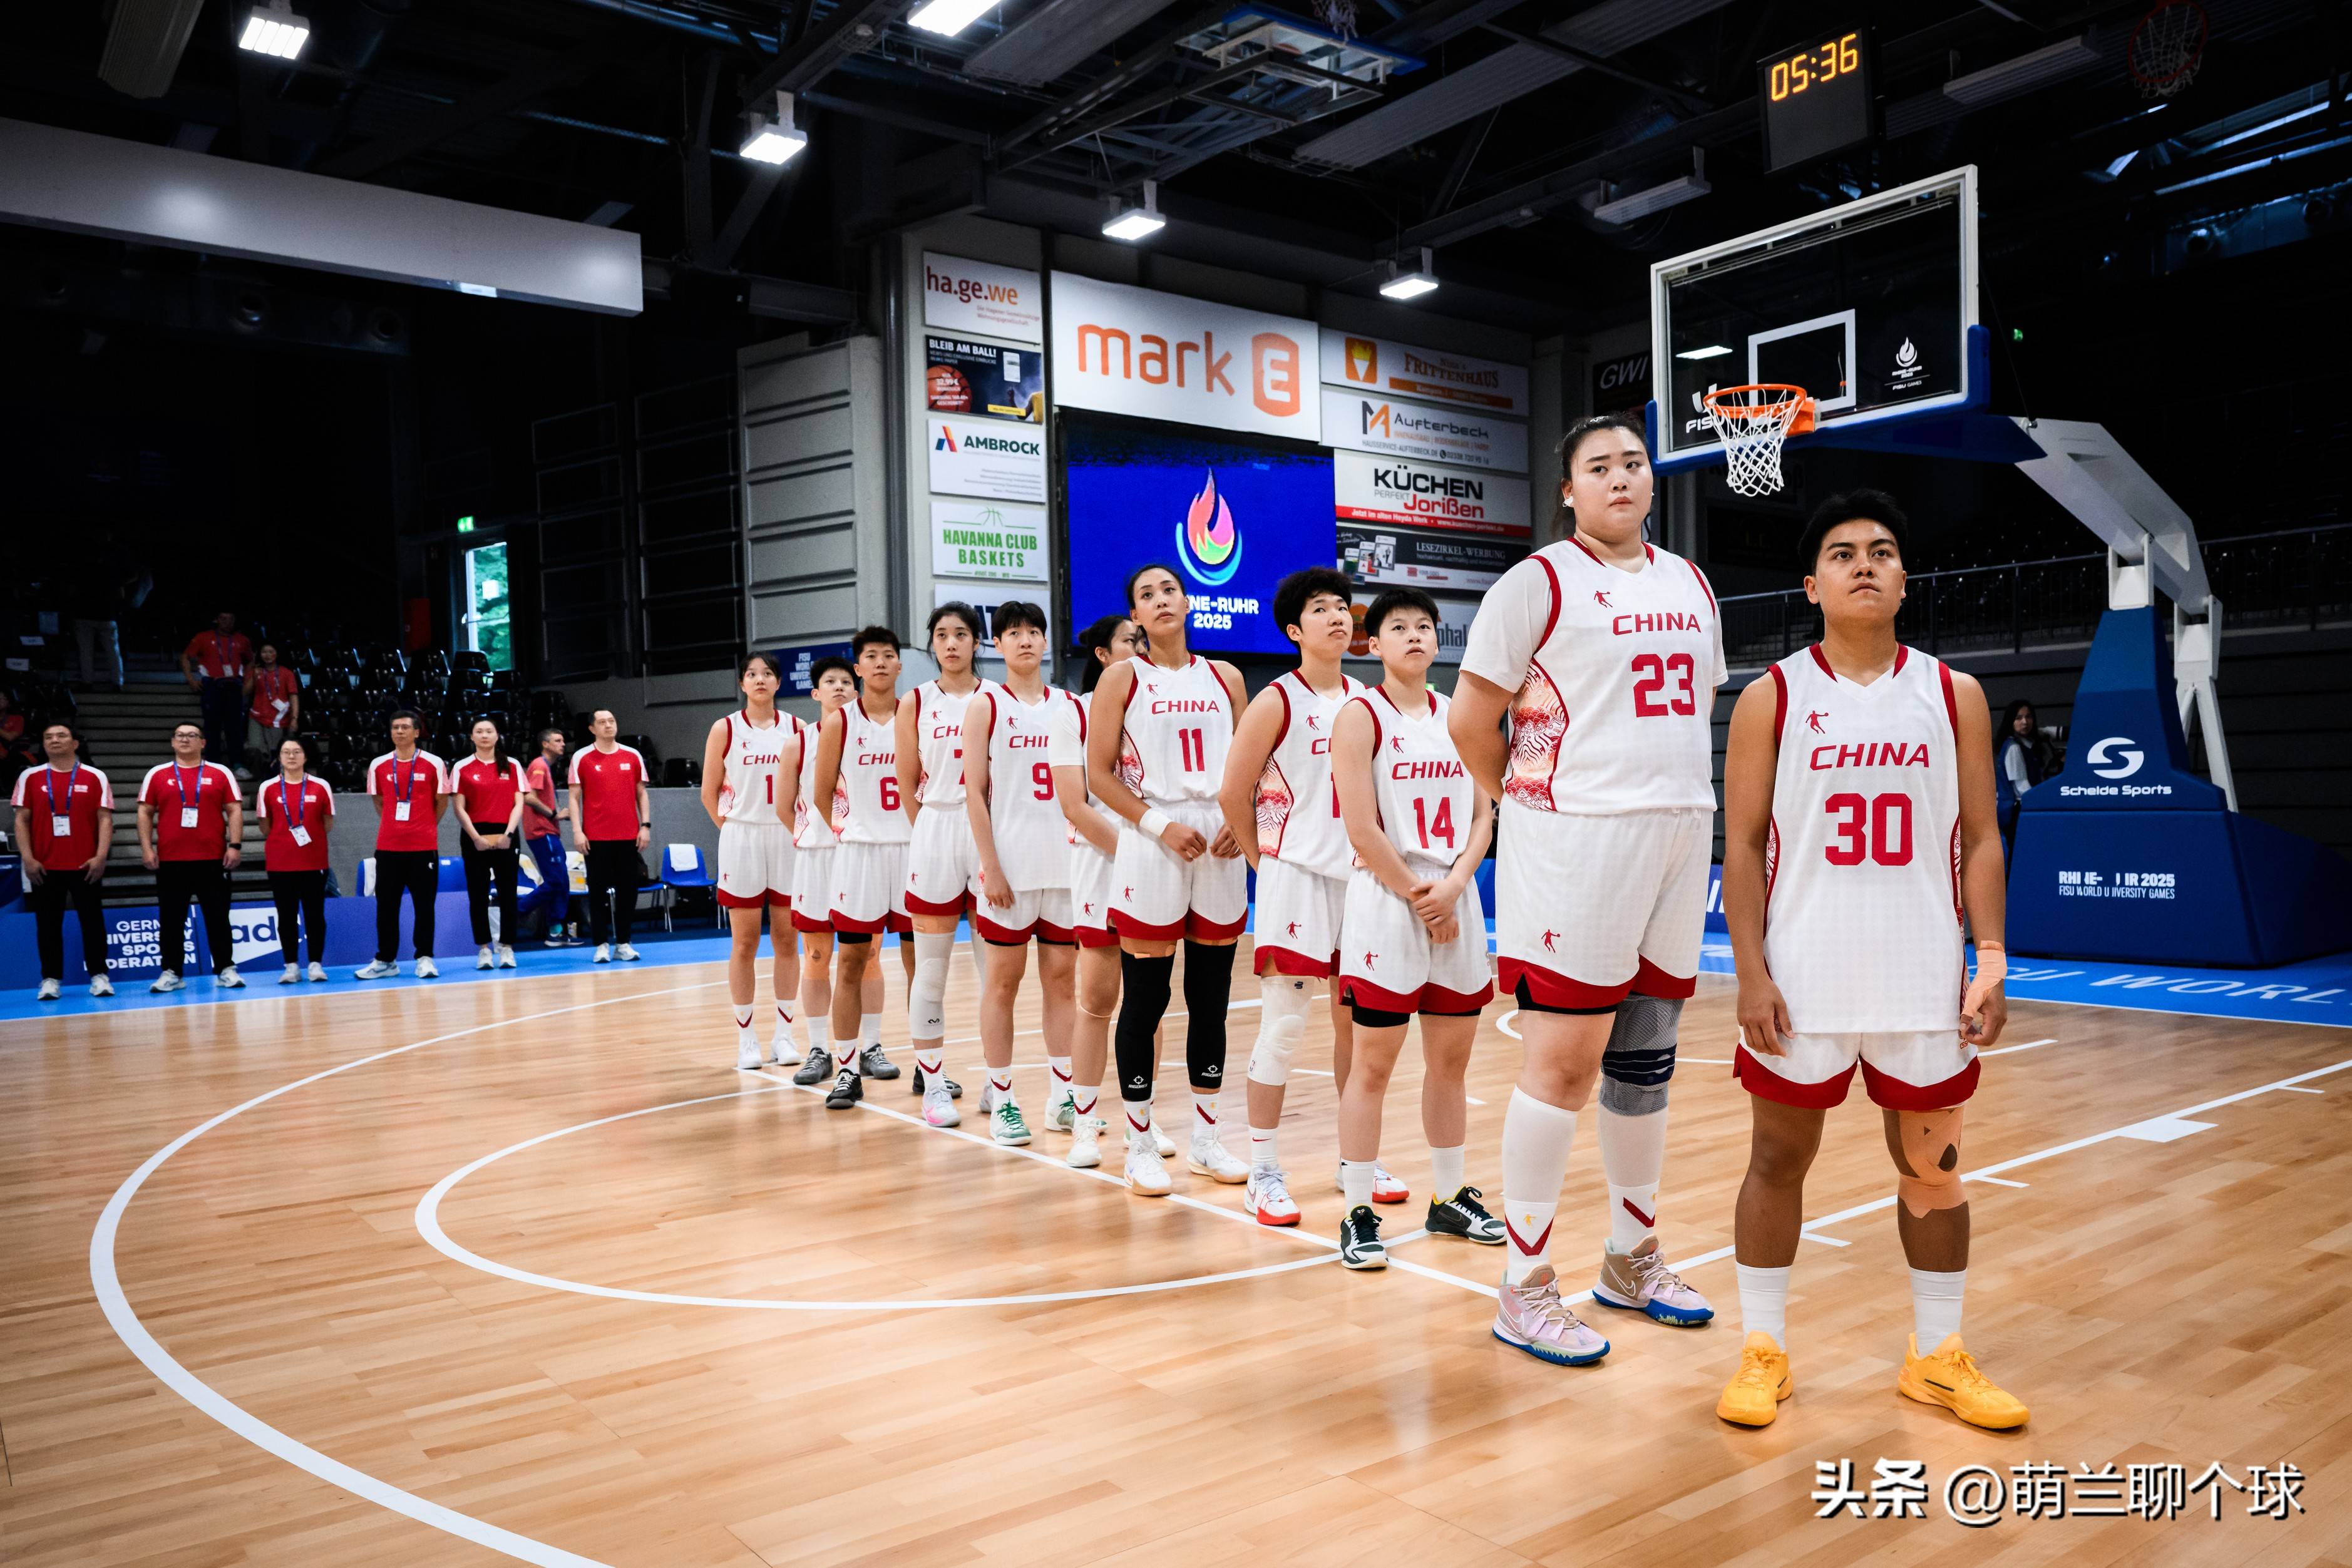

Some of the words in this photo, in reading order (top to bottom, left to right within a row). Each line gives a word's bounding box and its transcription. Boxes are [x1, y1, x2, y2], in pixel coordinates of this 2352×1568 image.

[1771, 33, 1857, 101] 05:36
[927, 265, 1018, 305] ha.ge.we
[929, 339, 954, 350] BLEIB
[956, 343, 970, 352] AM
[972, 346, 997, 357] BALL!
[1077, 324, 1235, 396] mark
[1404, 352, 1499, 389] FRITTENHAUS
[964, 436, 1040, 456] AMBROCK
[1374, 464, 1483, 500] KÜCHEN
[1374, 489, 1410, 501] PERFEKT
[1404, 494, 1484, 518] Jorißen
[943, 530, 1003, 548] HAVANNA
[1005, 533, 1037, 550] CLUB
[958, 549, 1024, 568] BASKETS
[1417, 542, 1506, 560] LESEZIRKEL-WERBUNG
[1188, 595, 1259, 614] NE-RUHR
[1193, 612, 1232, 630] 2025
[1613, 613, 1702, 635] CHINA
[1631, 653, 1695, 717] 23
[1151, 700, 1220, 715] CHINA
[1009, 735, 1049, 749] CHI
[1178, 728, 1205, 772] 11
[743, 753, 780, 766] CHIN
[858, 753, 895, 766] CHI
[1810, 742, 1929, 771] CHINA
[1392, 761, 1464, 780] CHINA
[1032, 762, 1054, 801] 9
[2060, 786, 2118, 796] Schelde
[2122, 785, 2172, 797] Sports
[880, 777, 900, 811] 6
[1413, 797, 1454, 849] 14
[1825, 793, 1913, 866] 30
[2141, 873, 2175, 887] 2025
[2059, 886, 2075, 896] FISU
[2149, 888, 2175, 899] GAMES
[2089, 974, 2352, 1005] WORL
